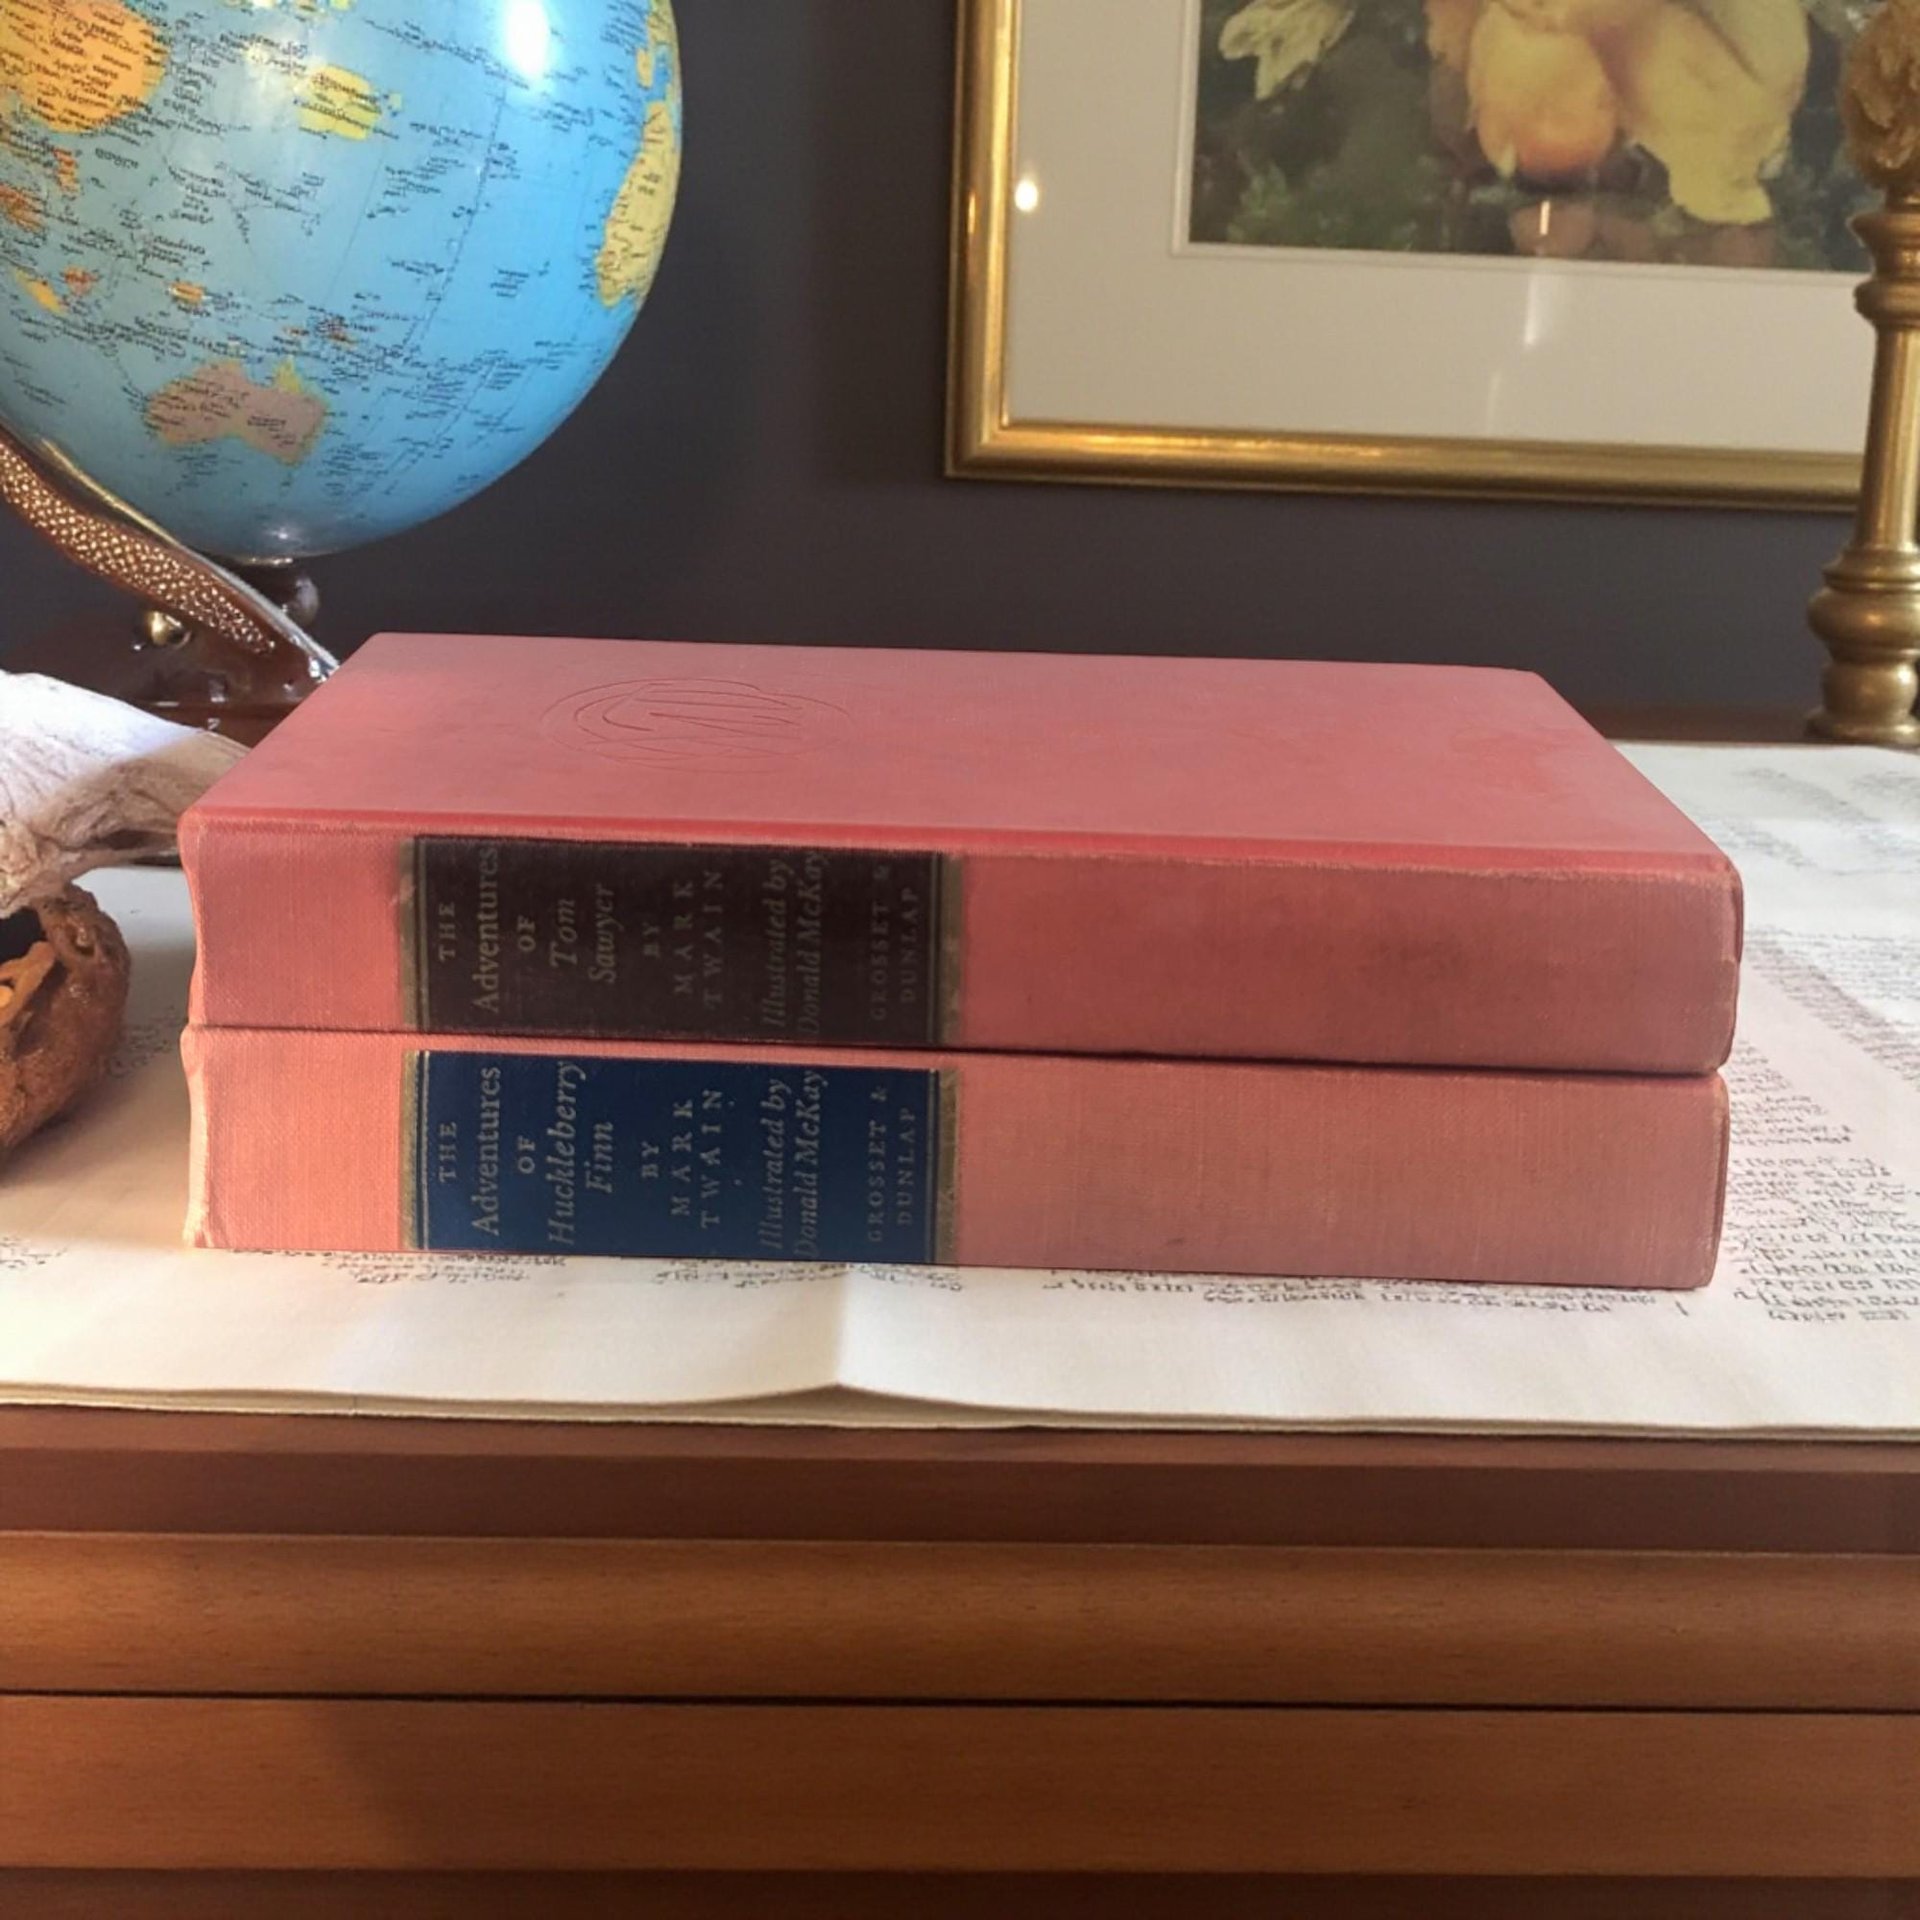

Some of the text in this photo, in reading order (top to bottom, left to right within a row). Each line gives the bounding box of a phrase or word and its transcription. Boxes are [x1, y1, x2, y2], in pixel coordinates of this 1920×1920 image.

[439, 902, 455, 962] THE
[472, 848, 498, 1013] Adventures
[517, 916, 536, 951] OF
[550, 900, 577, 968] Tom
[589, 883, 624, 983] Sawyer
[643, 923, 660, 957] BY
[674, 881, 693, 994] MARK
[703, 870, 723, 1010] TWAIN
[762, 859, 795, 1027] Illustrated by
[797, 852, 829, 1034] Donald McKay
[901, 888, 918, 1002] DUNLAP
[439, 1121, 457, 1182] THE
[471, 1066, 500, 1235] Adventures
[517, 1136, 535, 1174] OF
[546, 1061, 586, 1244] Huckleberry
[584, 1121, 613, 1193] Finn
[641, 1141, 659, 1178] BY
[671, 1100, 693, 1216] MARK
[700, 1089, 722, 1229] TWAIN
[758, 1079, 792, 1249] Illustrated by
[793, 1070, 828, 1257] Donald McKay
[867, 1120, 886, 1242] GROSSET
[897, 1108, 915, 1225] DUNLAP
